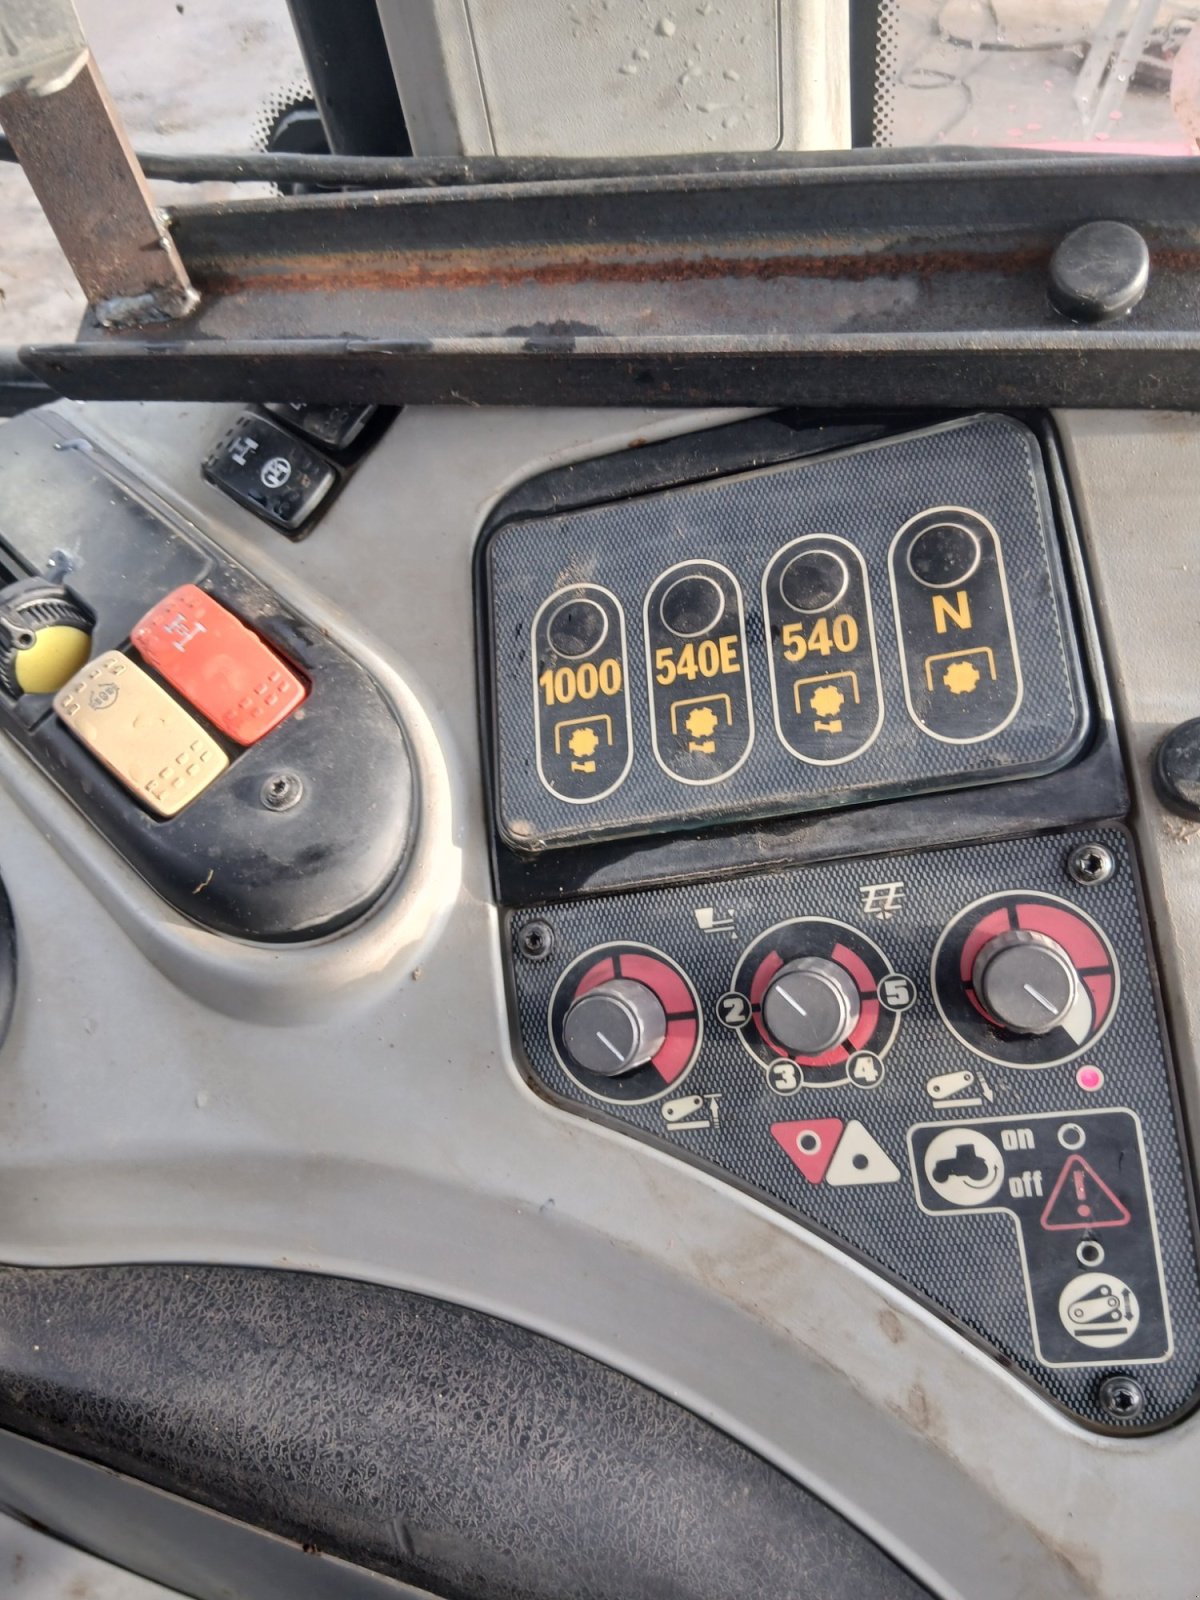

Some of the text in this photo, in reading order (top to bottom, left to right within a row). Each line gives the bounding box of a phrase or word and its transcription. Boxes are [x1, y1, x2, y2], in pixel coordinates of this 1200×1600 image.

[932, 590, 972, 634] N
[782, 614, 858, 662] 540
[655, 635, 741, 686] 540E
[540, 658, 622, 706] 1000
[884, 979, 909, 1006] 5
[723, 998, 745, 1022] 2
[773, 1063, 797, 1089] 3
[853, 1056, 879, 1083] 4
[1001, 1128, 1036, 1151] on
[1008, 1170, 1043, 1198] off
